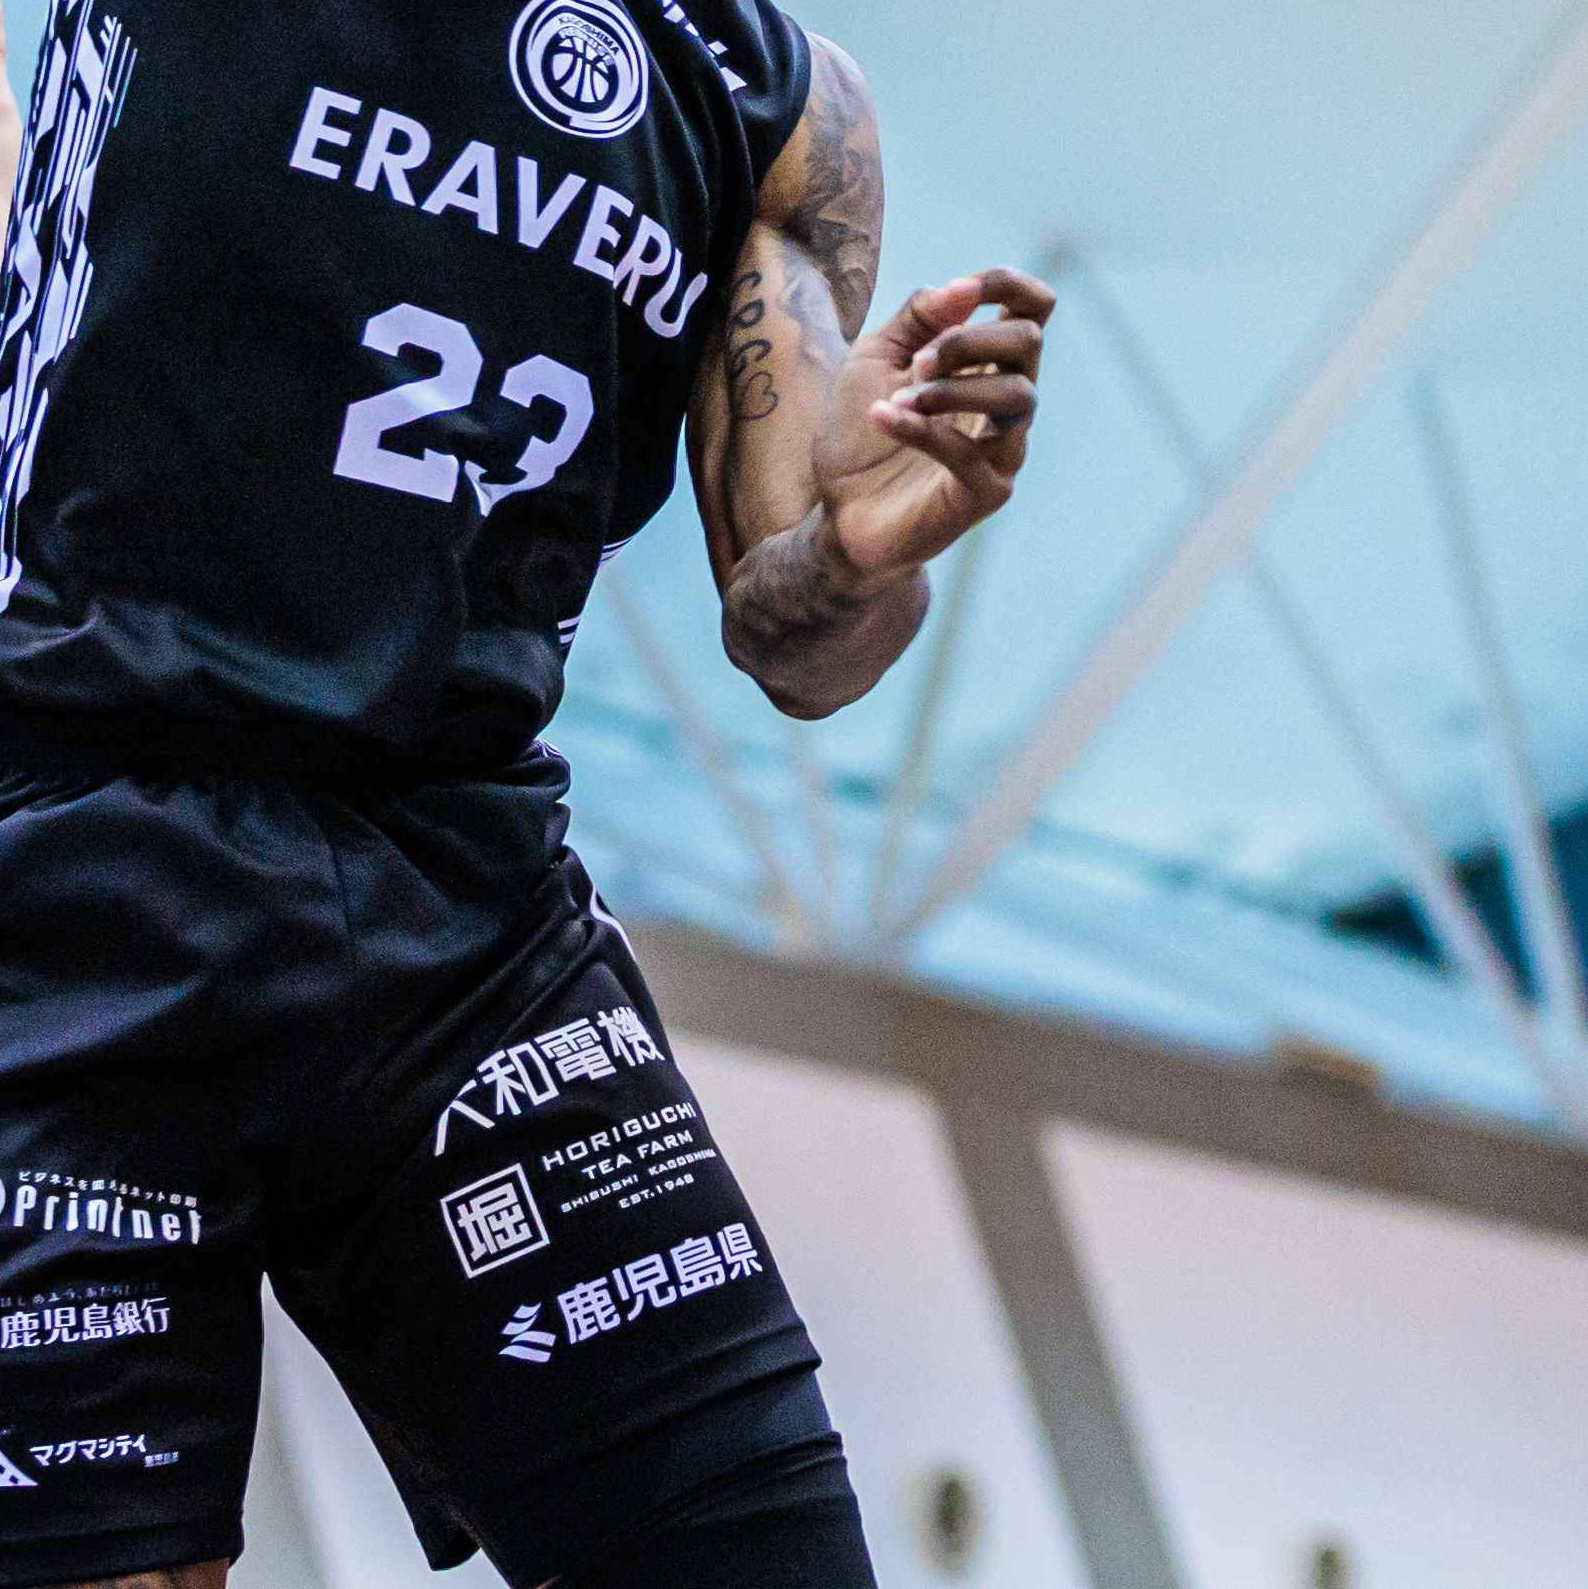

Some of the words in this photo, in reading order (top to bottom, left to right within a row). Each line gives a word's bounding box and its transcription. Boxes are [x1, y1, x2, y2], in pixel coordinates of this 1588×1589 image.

[289, 86, 708, 338] ERAVERU
[333, 302, 594, 517] 23
[542, 1102, 697, 1172] HORIGUCHI
[581, 1153, 632, 1181] TEA
[637, 1129, 694, 1160] FARM
[561, 1174, 638, 1213] SHIBUSHI
[647, 1148, 717, 1178] KAGOSHIMA
[618, 1173, 695, 1210] EST.1948
[13, 1184, 202, 1246] Printnet
[557, 1222, 763, 1344] 鹿児島県
[0, 1297, 171, 1350] 鹿児島銀行
[29, 1433, 147, 1467] マグマシティ
